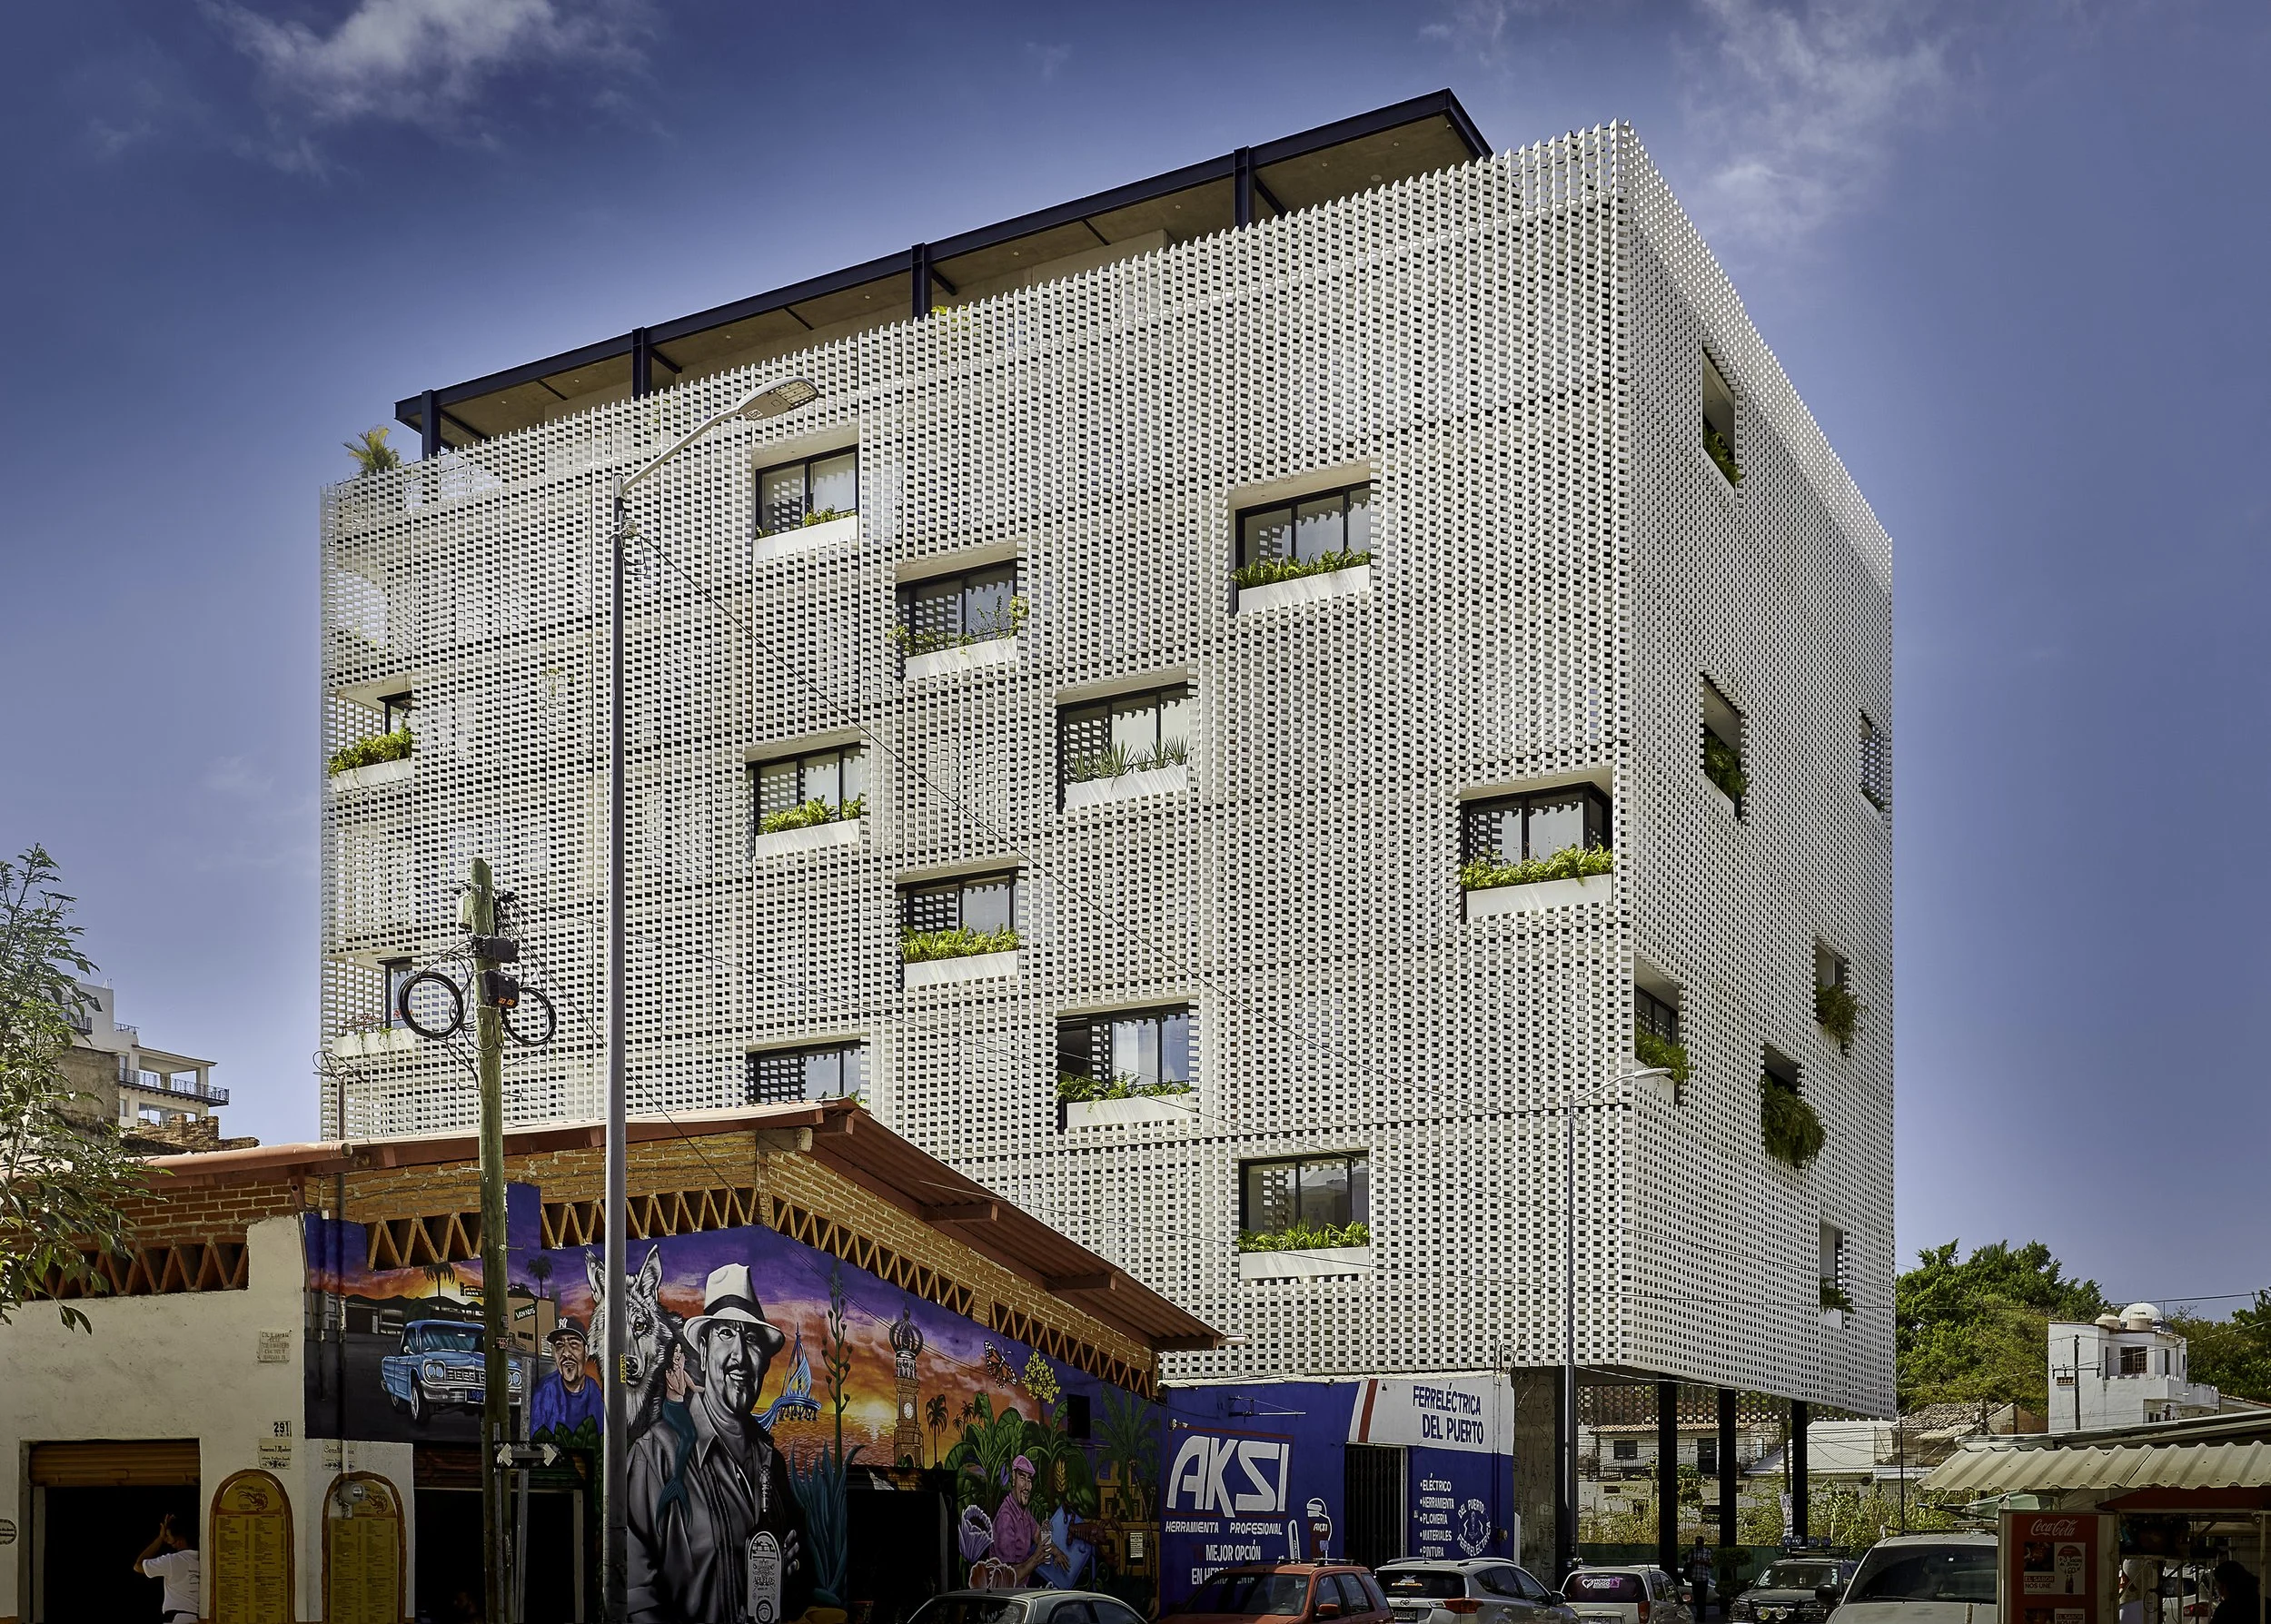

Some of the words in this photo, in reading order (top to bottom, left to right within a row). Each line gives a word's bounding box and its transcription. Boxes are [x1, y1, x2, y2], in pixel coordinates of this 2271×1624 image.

[1413, 1382, 1482, 1415] FERRELÉCTRICA
[273, 1421, 289, 1433] 291
[1423, 1414, 1443, 1440] DEL
[1447, 1417, 1484, 1444] PUERTO
[1166, 1435, 1290, 1518] AKSI
[1423, 1472, 1452, 1491] ELÉCTRICO
[1422, 1496, 1454, 1510] HERRAMIENTA
[1457, 1503, 1467, 1520] DEL
[1467, 1499, 1485, 1514] PUERTO
[1423, 1510, 1448, 1525] PLOMERÍA
[1165, 1520, 1219, 1534] HERRAMIENTA
[1229, 1521, 1283, 1536] PROFESIONAL
[1422, 1530, 1453, 1541] MATERIALES
[1205, 1544, 1234, 1561] MEJOR
[1235, 1540, 1261, 1561] OPCIÓN
[1423, 1546, 1444, 1557] PINTURA
[1191, 1568, 1203, 1585] EN
